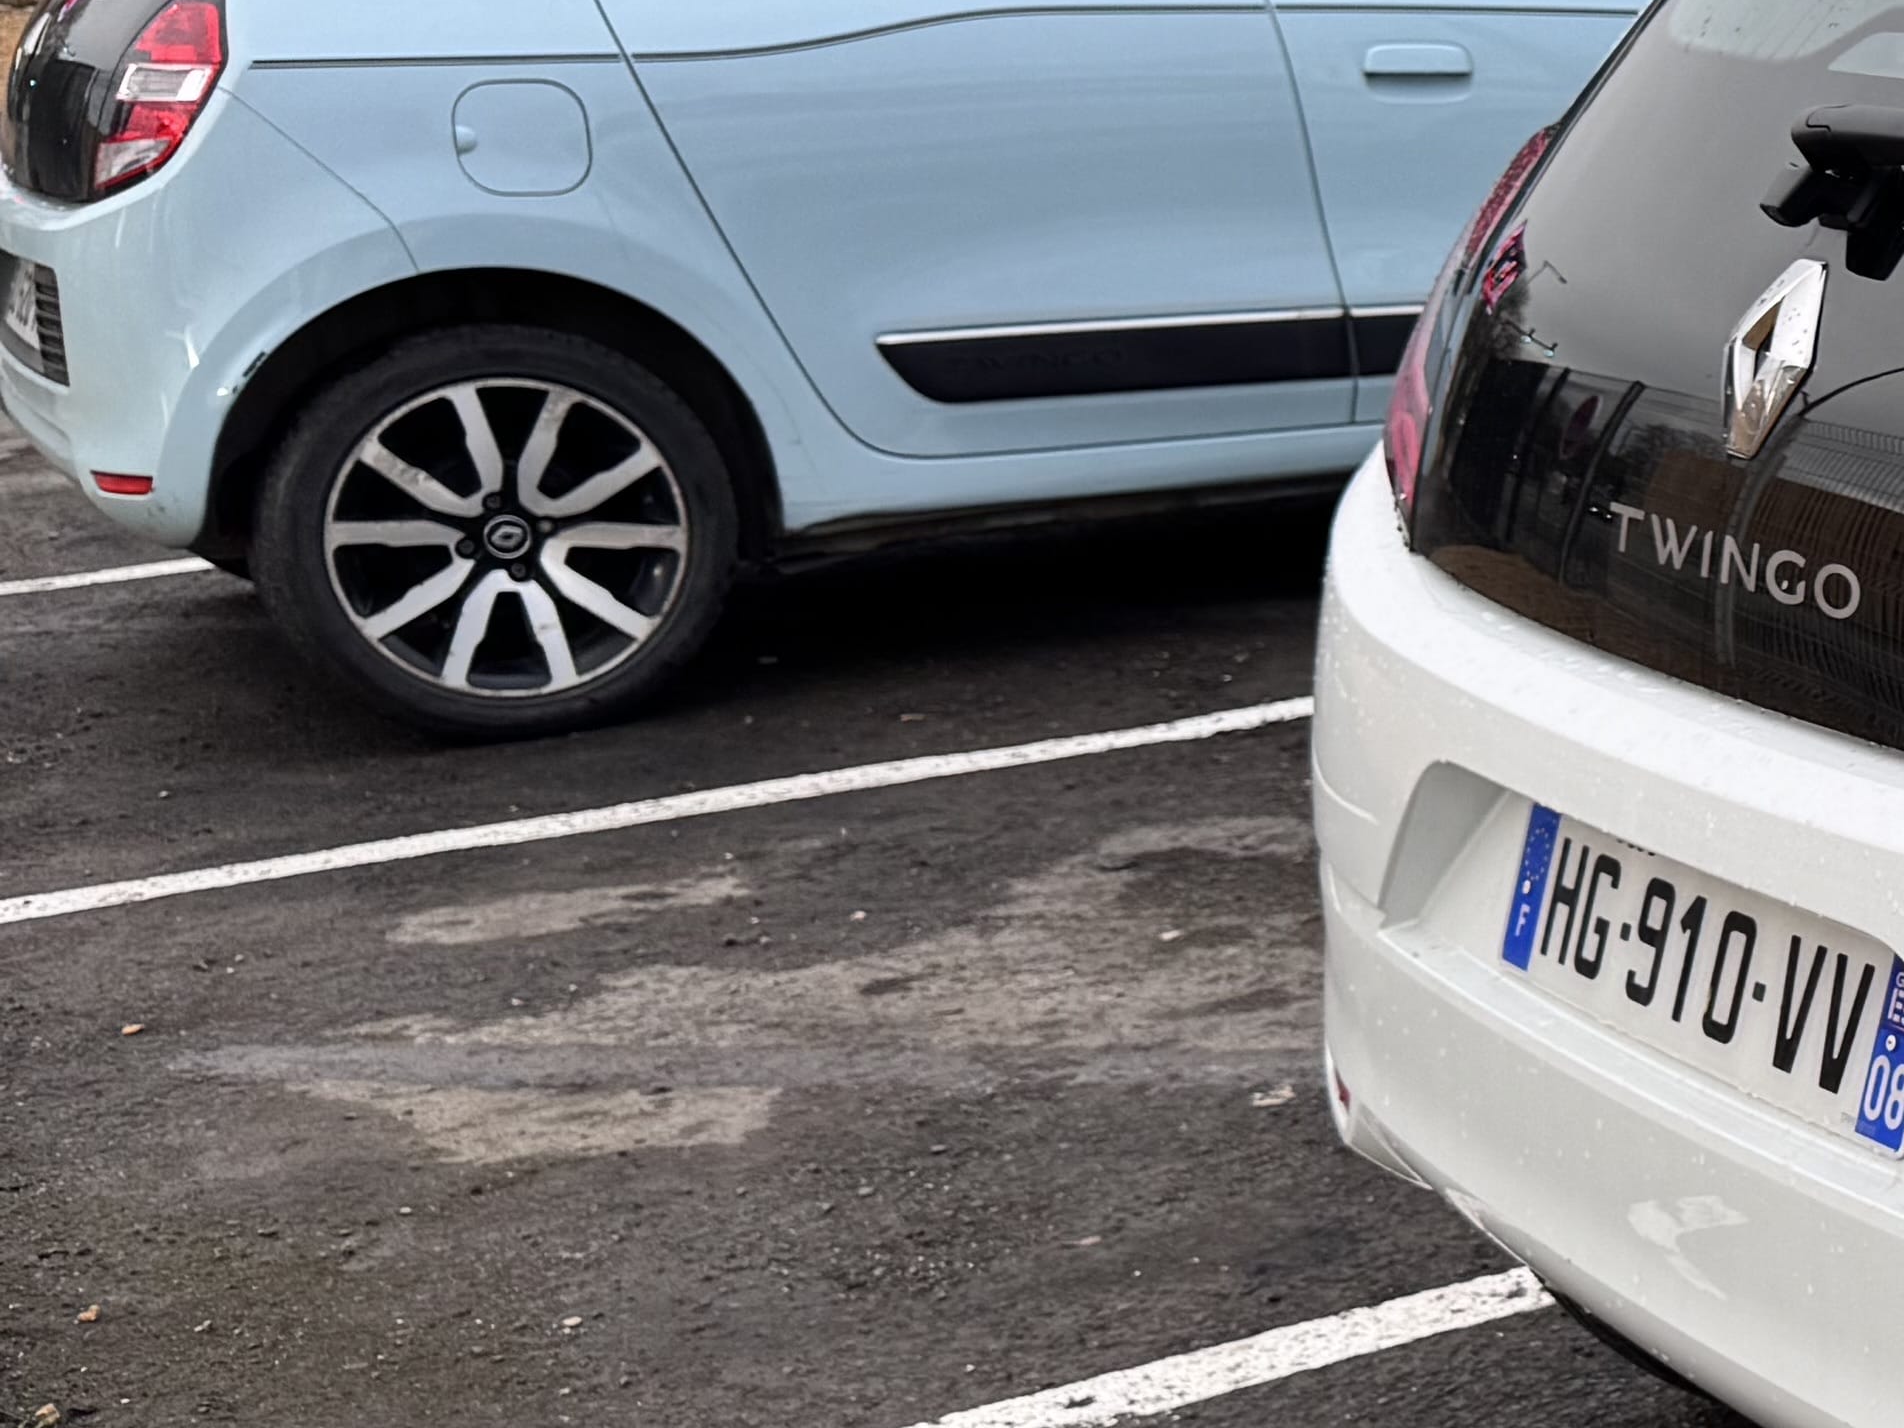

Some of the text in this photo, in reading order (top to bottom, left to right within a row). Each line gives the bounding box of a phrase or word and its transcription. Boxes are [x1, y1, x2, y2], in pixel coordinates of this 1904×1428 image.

[1609, 501, 1862, 620] TWINGO
[1515, 903, 1531, 937] F
[1540, 837, 1876, 1095] HG-910-VV
